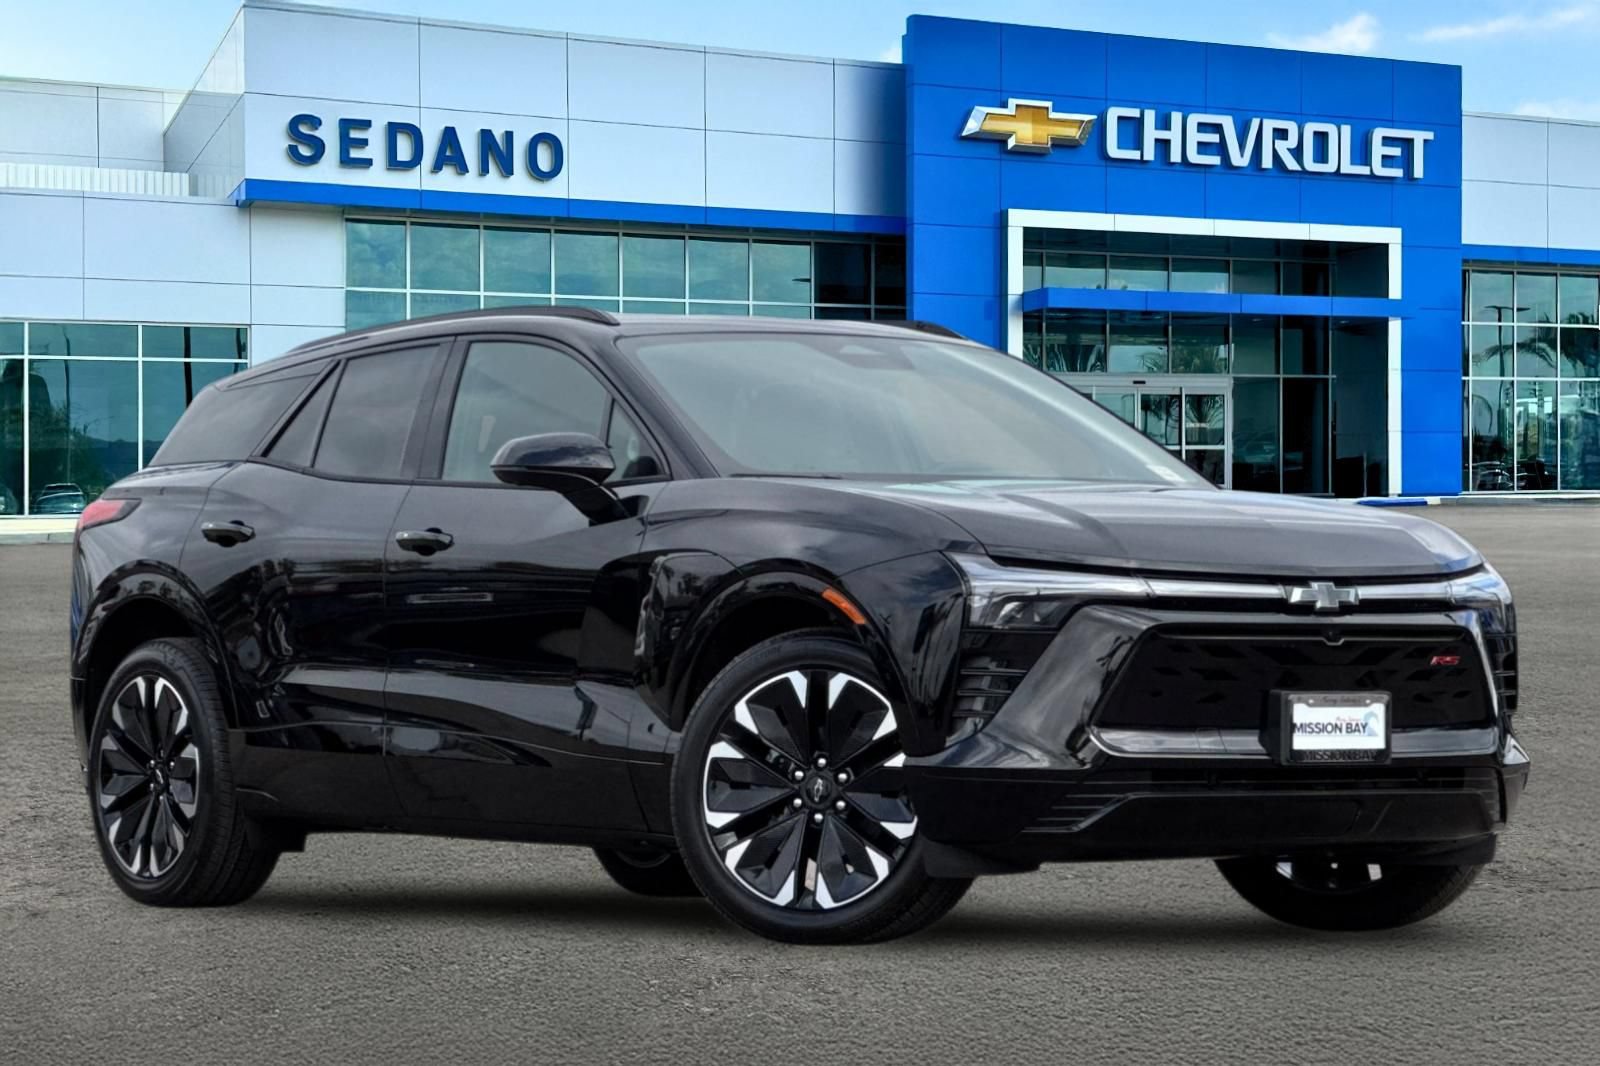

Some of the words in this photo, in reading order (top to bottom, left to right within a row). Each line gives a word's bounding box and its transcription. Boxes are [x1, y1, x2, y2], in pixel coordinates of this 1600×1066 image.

[287, 113, 564, 181] SEDANO
[1105, 106, 1434, 179] CHEVROLET
[1431, 655, 1460, 665] RS
[1293, 722, 1342, 734] MISSION
[1345, 722, 1368, 734] BAY
[1304, 749, 1351, 761] MISSION
